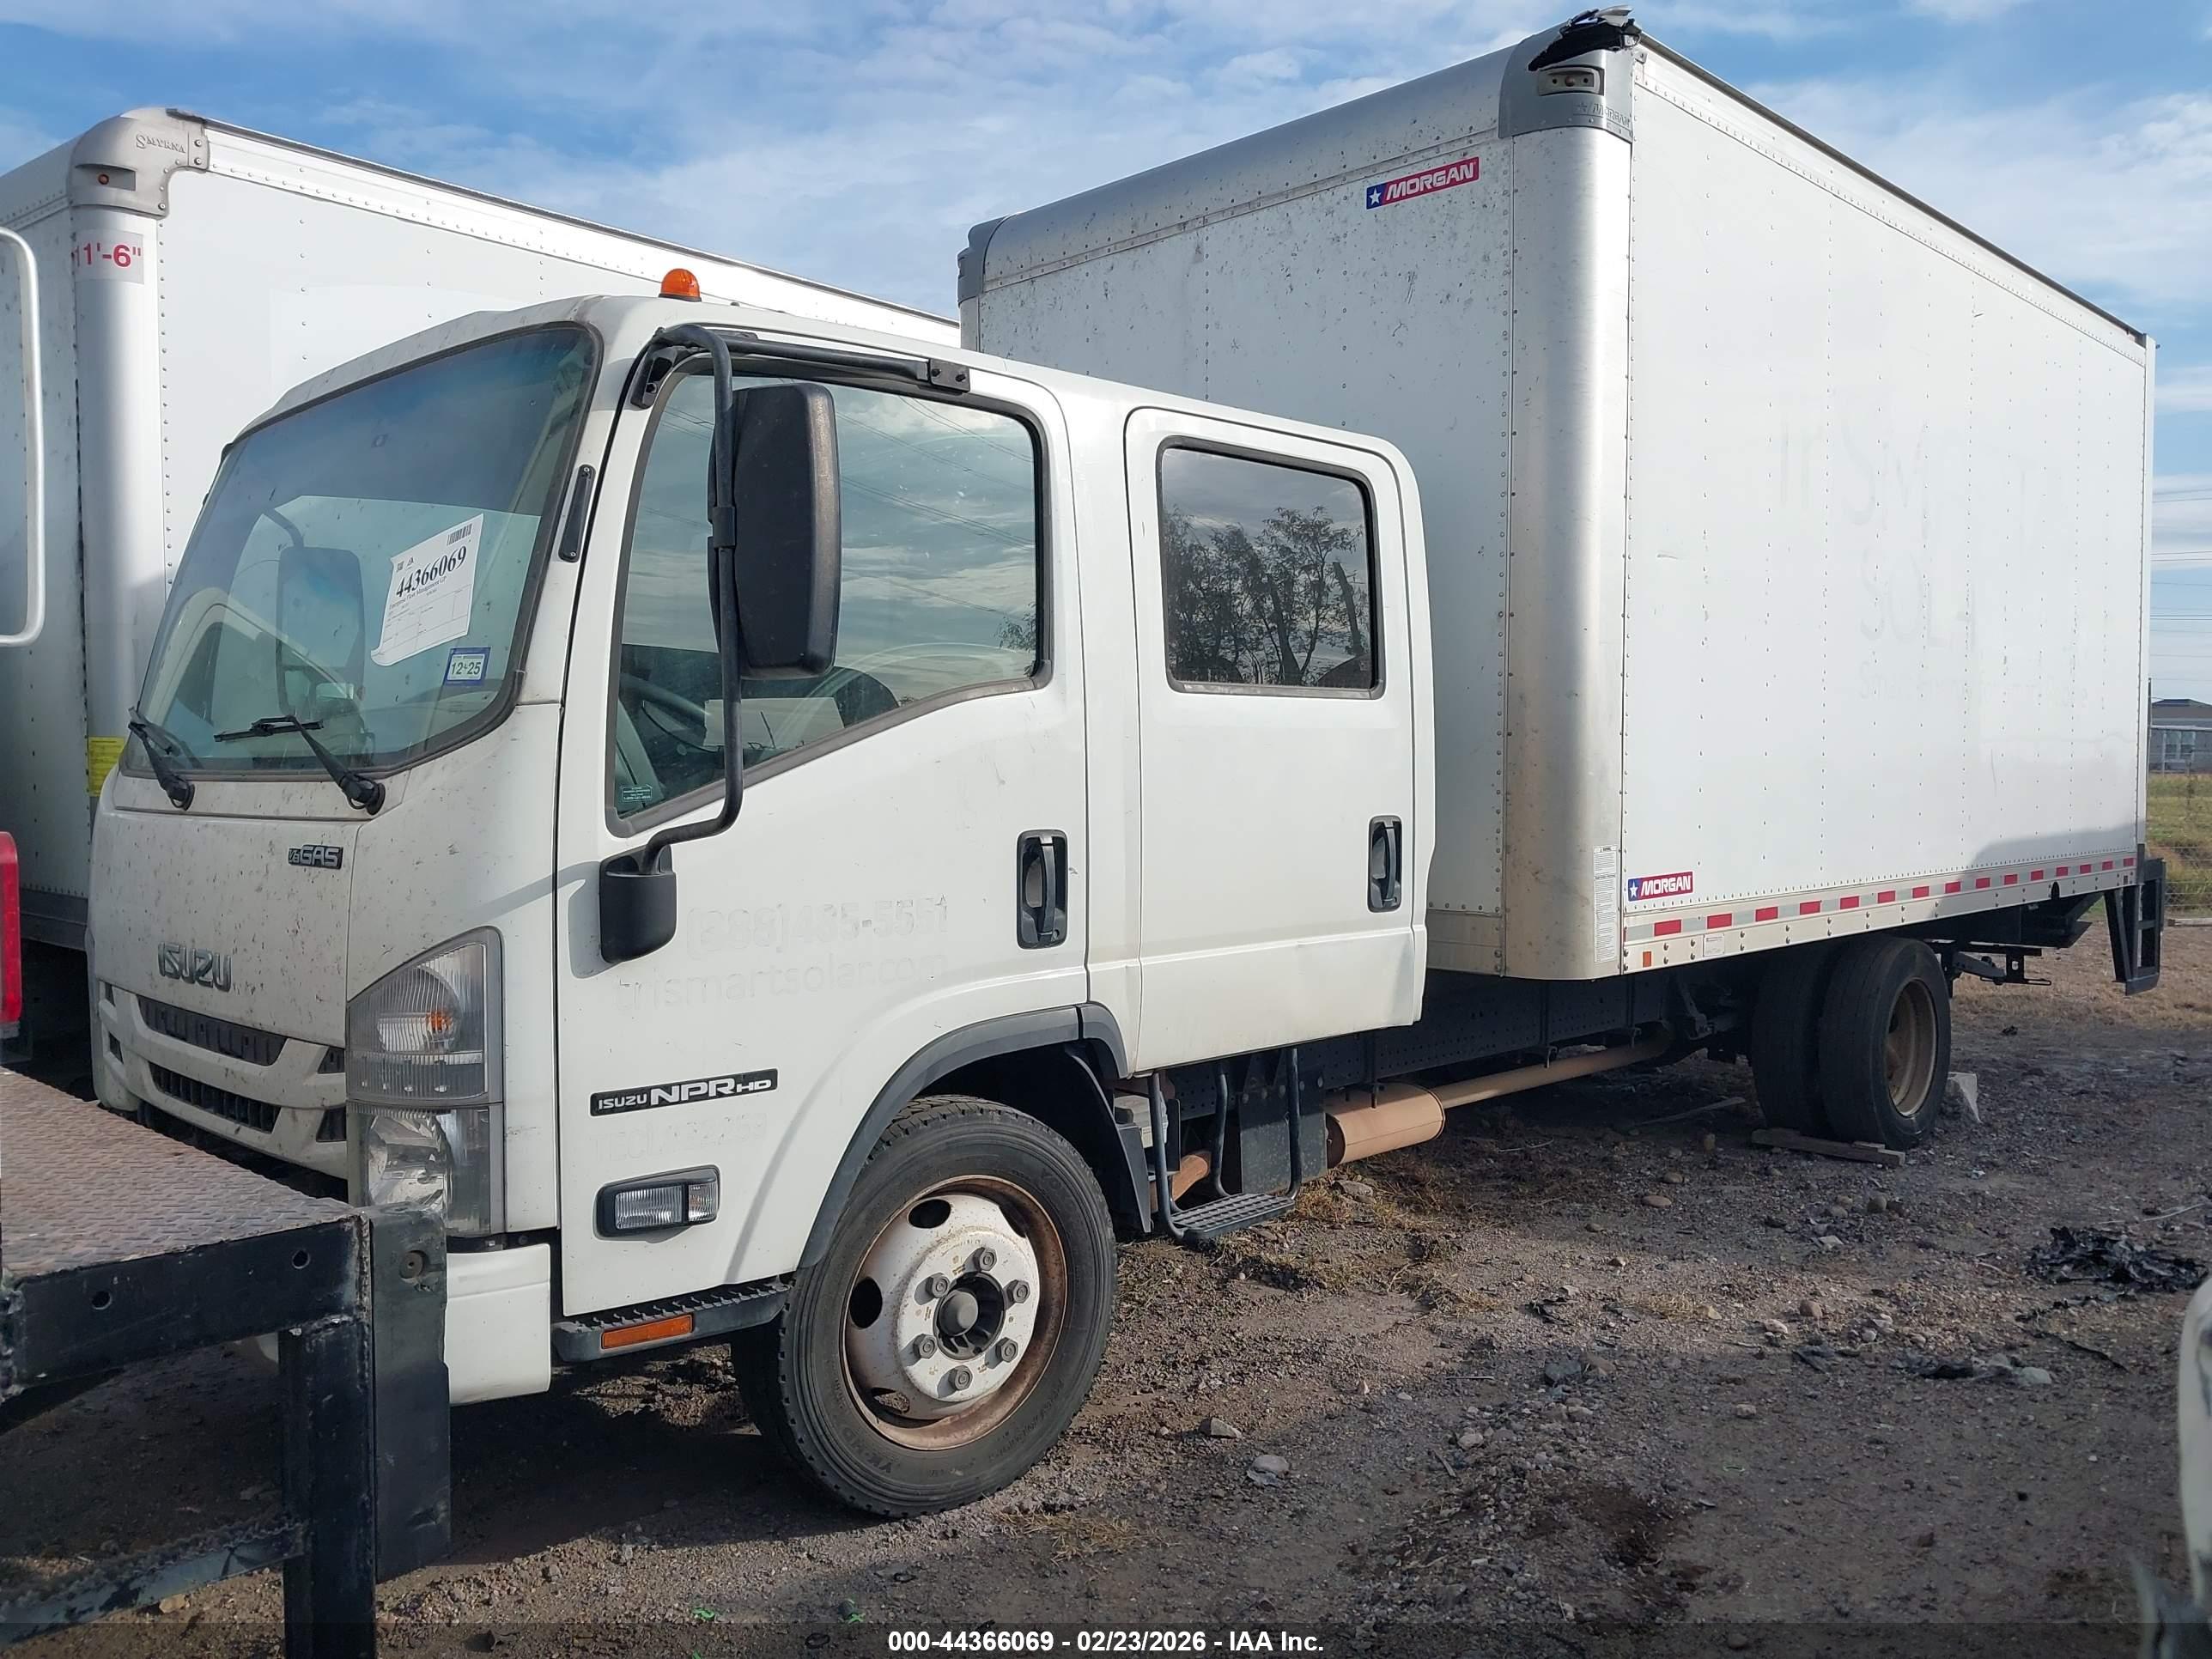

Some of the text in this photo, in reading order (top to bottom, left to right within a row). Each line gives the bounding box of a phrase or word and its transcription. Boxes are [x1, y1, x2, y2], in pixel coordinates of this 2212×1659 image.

[136, 134, 185, 154] SMYRNA
[1385, 161, 1475, 201] MORGAN
[396, 545, 467, 598] 44366069
[301, 846, 339, 867] GAS
[1639, 874, 1691, 896] MORGAN
[158, 941, 232, 993] ISUZU
[598, 1078, 772, 1110] ISUZU NPR HD
